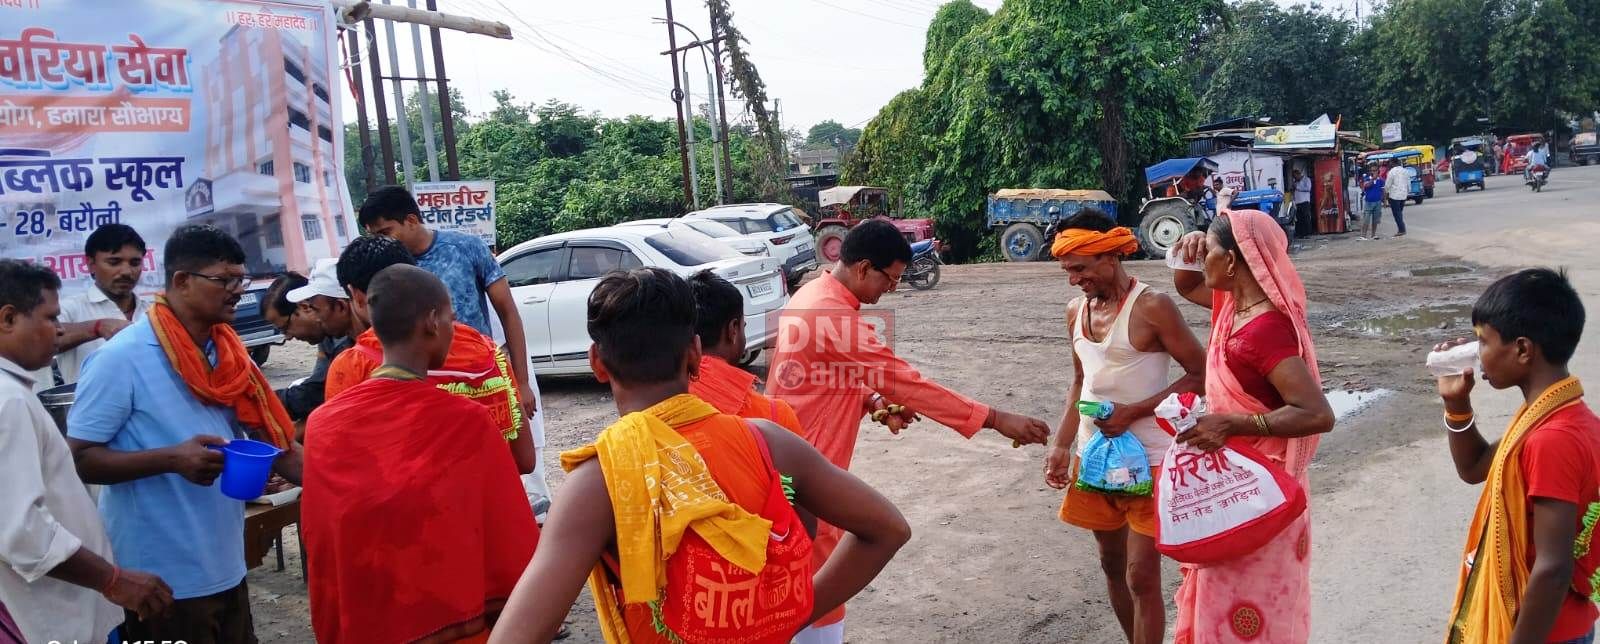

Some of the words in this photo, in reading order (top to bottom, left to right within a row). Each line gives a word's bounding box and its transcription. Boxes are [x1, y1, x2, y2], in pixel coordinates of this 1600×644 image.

[111, 33, 188, 85] सेवा
[43, 106, 106, 126] हमारा
[109, 101, 183, 126] सौभाग्य
[99, 157, 185, 202] स्कूल
[417, 186, 488, 208] महावीर
[15, 211, 52, 237] 28,
[694, 561, 759, 630] बोल
